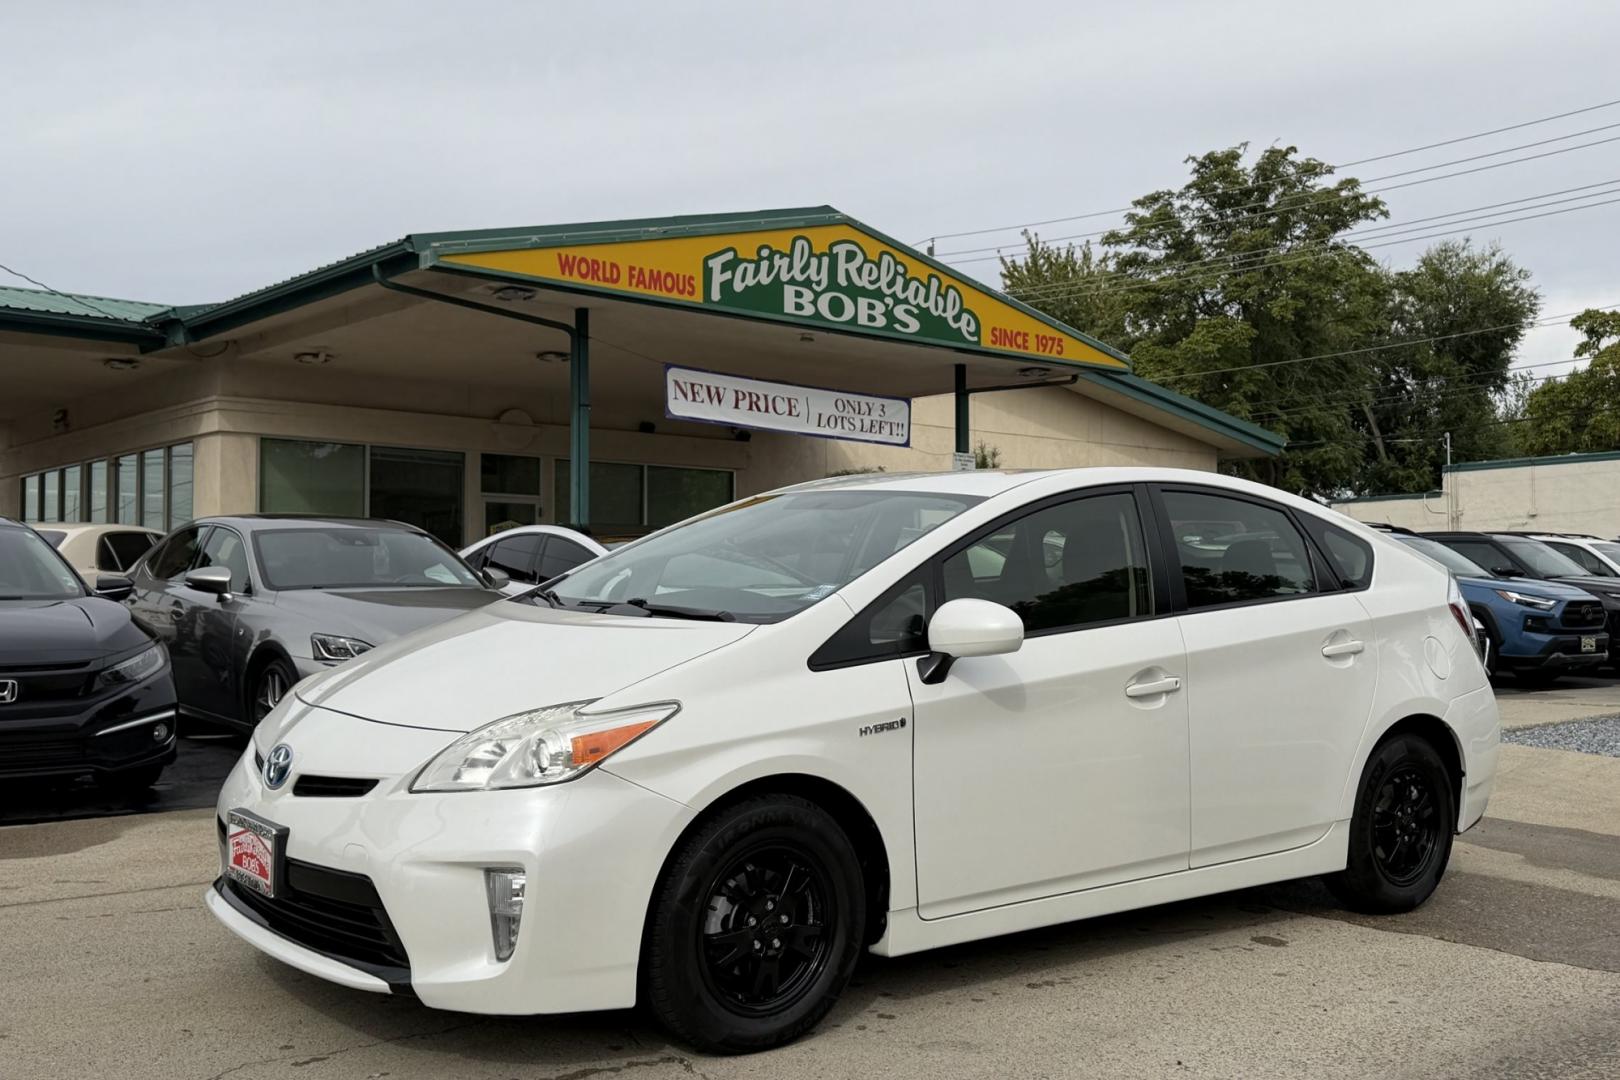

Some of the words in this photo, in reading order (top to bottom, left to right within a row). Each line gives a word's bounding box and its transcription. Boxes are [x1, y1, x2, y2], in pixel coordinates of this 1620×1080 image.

[557, 252, 621, 285] WORLD
[628, 265, 696, 297] FAMOUS
[707, 239, 830, 302] Fairly
[832, 242, 978, 342] Reliable
[783, 284, 921, 334] BOB'S
[990, 326, 1030, 351] SINCE
[1035, 334, 1064, 356] 1975
[672, 379, 727, 407] NEW
[732, 388, 801, 418] PRICE
[834, 398, 875, 417] ONLY
[878, 403, 886, 418] 3
[817, 412, 856, 432] LOTS
[860, 418, 905, 437] LEFT!!
[859, 720, 899, 737] HYBRID
